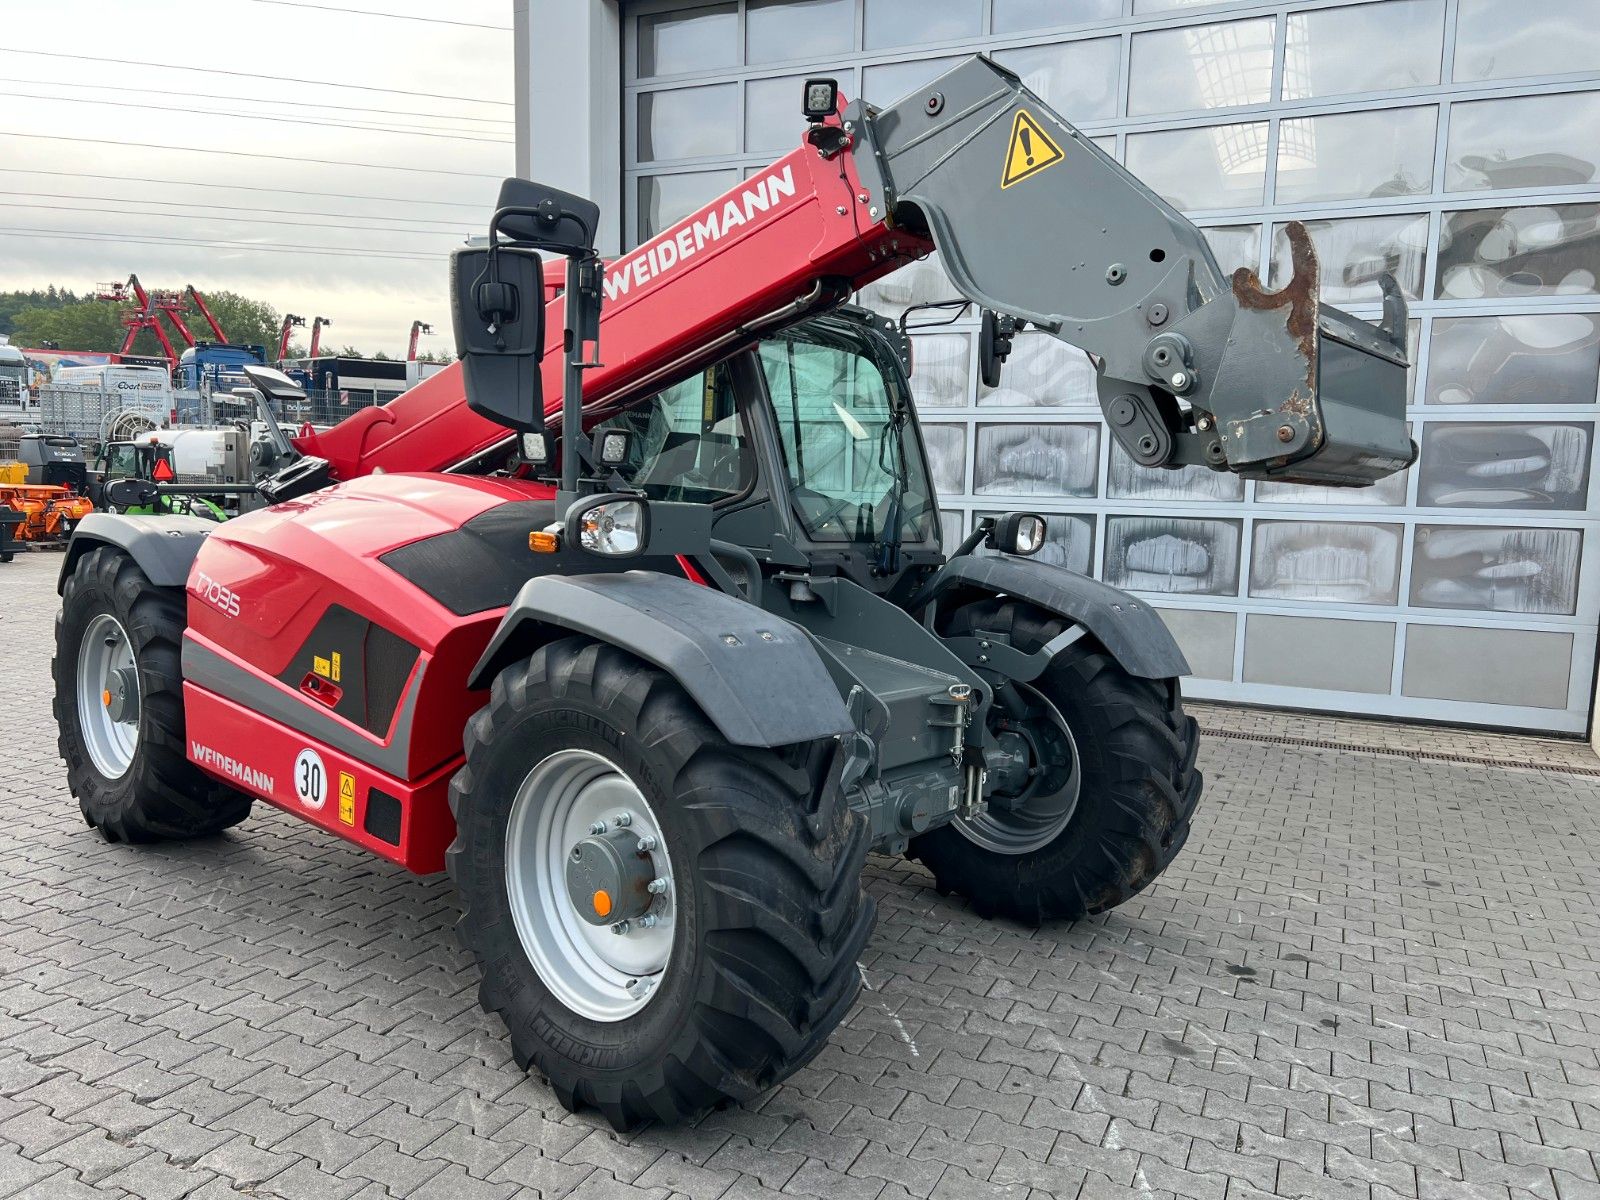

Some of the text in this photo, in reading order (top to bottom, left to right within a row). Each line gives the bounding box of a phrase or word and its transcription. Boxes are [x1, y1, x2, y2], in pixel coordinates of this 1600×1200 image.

[602, 164, 796, 302] WEIDEMANN
[195, 571, 241, 617] T7035
[191, 740, 275, 795] WEIDEMANN
[299, 758, 321, 803] 30
